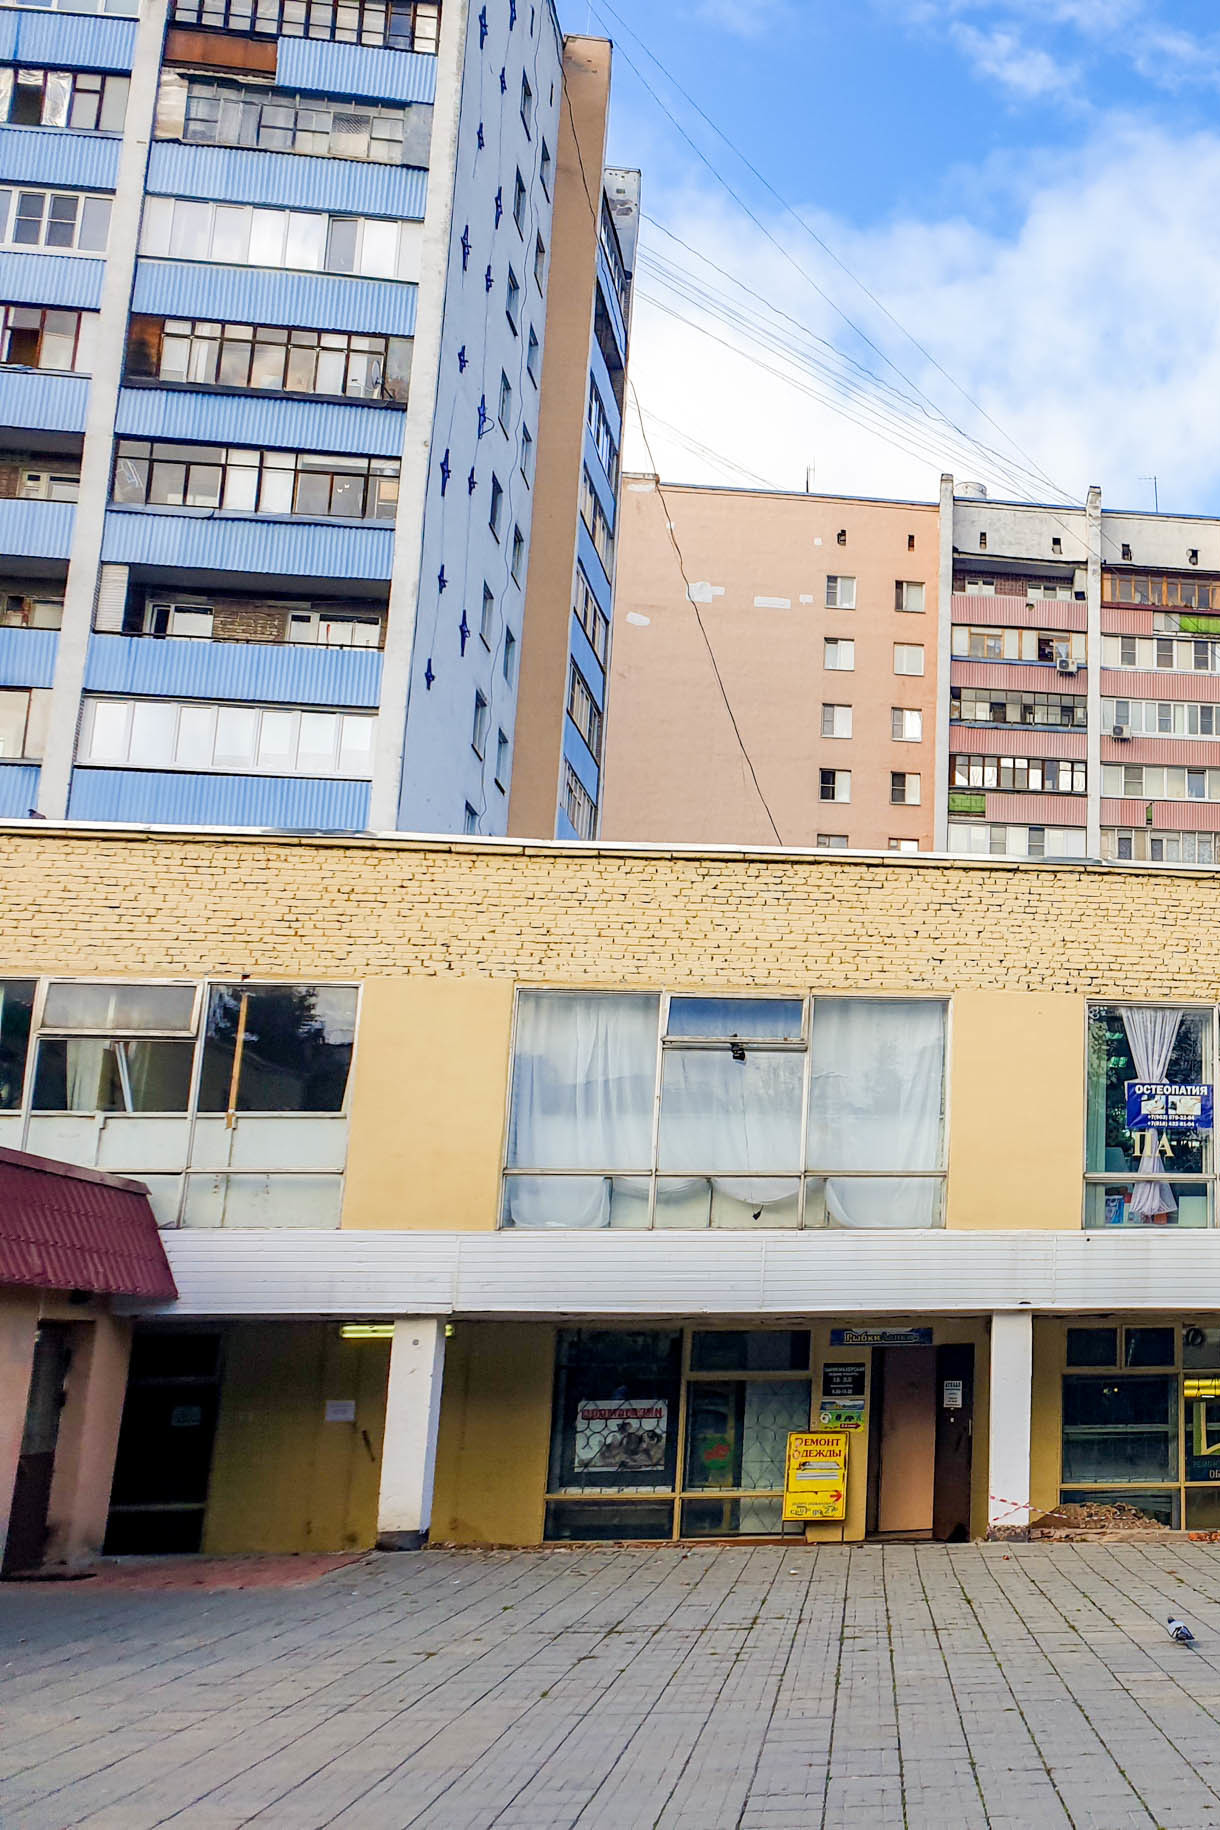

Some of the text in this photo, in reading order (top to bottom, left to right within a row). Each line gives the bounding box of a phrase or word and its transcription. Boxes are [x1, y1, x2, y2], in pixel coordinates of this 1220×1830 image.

[1135, 1085, 1208, 1095] ОСТЕОПАТИЯ
[795, 1438, 841, 1447] РЕМОНТ
[793, 1449, 841, 1459] ОДЕЖДЫ
